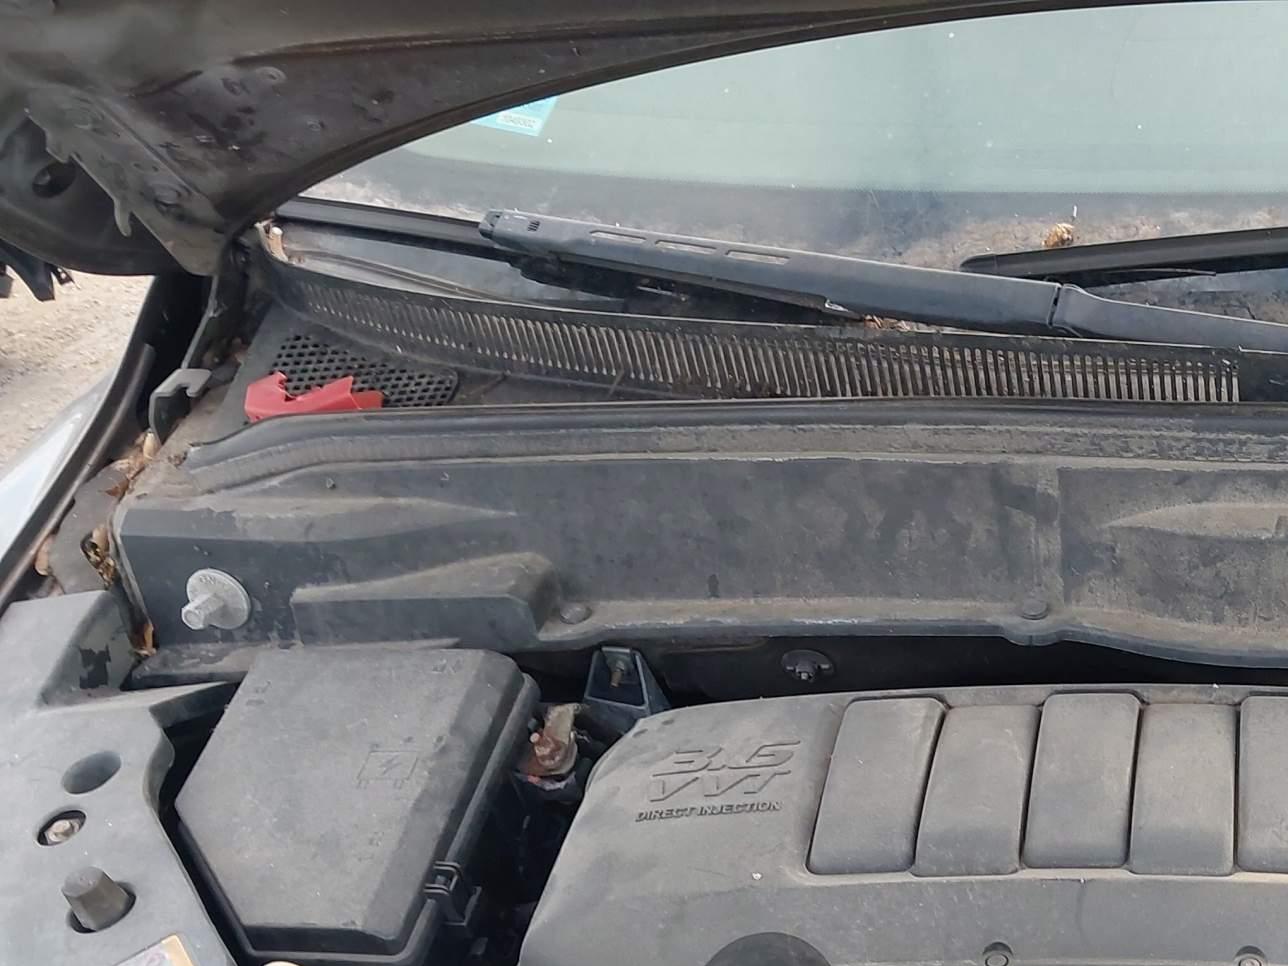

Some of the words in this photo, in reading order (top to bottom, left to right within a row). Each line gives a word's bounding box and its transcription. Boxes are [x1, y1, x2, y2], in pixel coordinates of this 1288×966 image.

[649, 769, 792, 803] VVT
[635, 807, 694, 823] DIRECT
[697, 801, 782, 817] INJECTION
